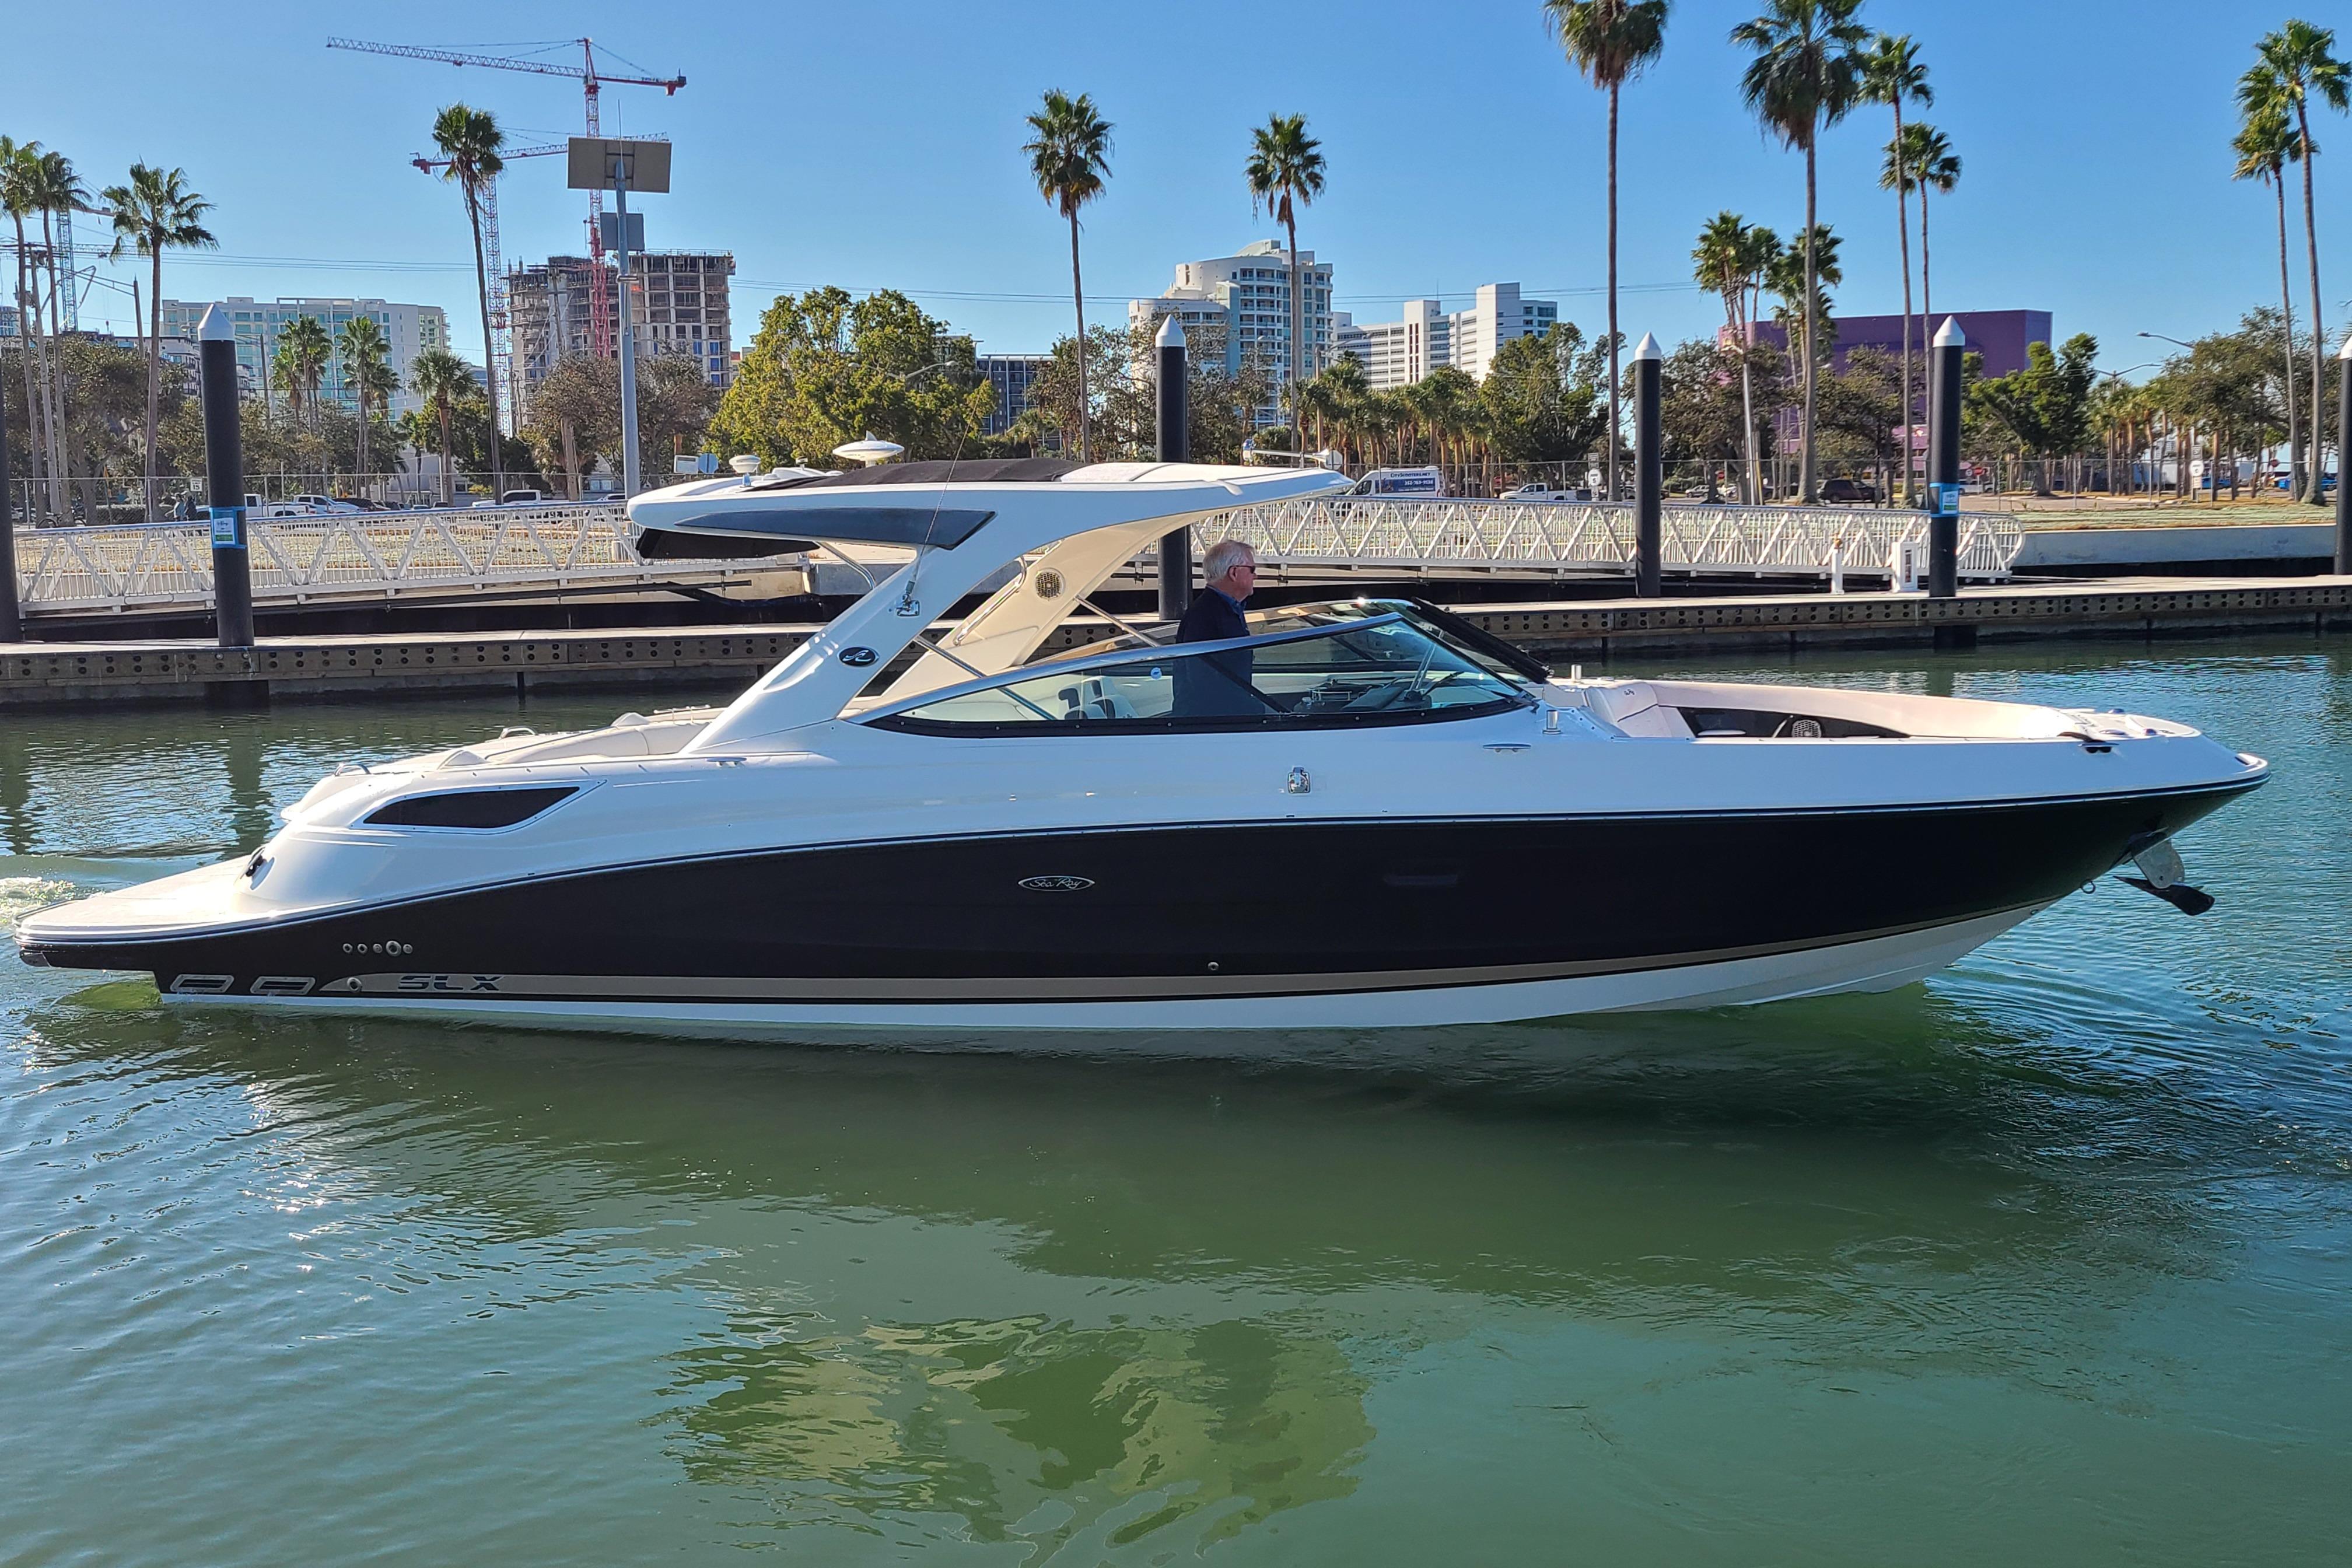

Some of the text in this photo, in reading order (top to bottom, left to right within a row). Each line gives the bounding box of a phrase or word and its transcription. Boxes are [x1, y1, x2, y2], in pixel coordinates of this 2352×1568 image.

[1029, 877, 1082, 889] Sea Ray
[398, 975, 503, 991] SLX
